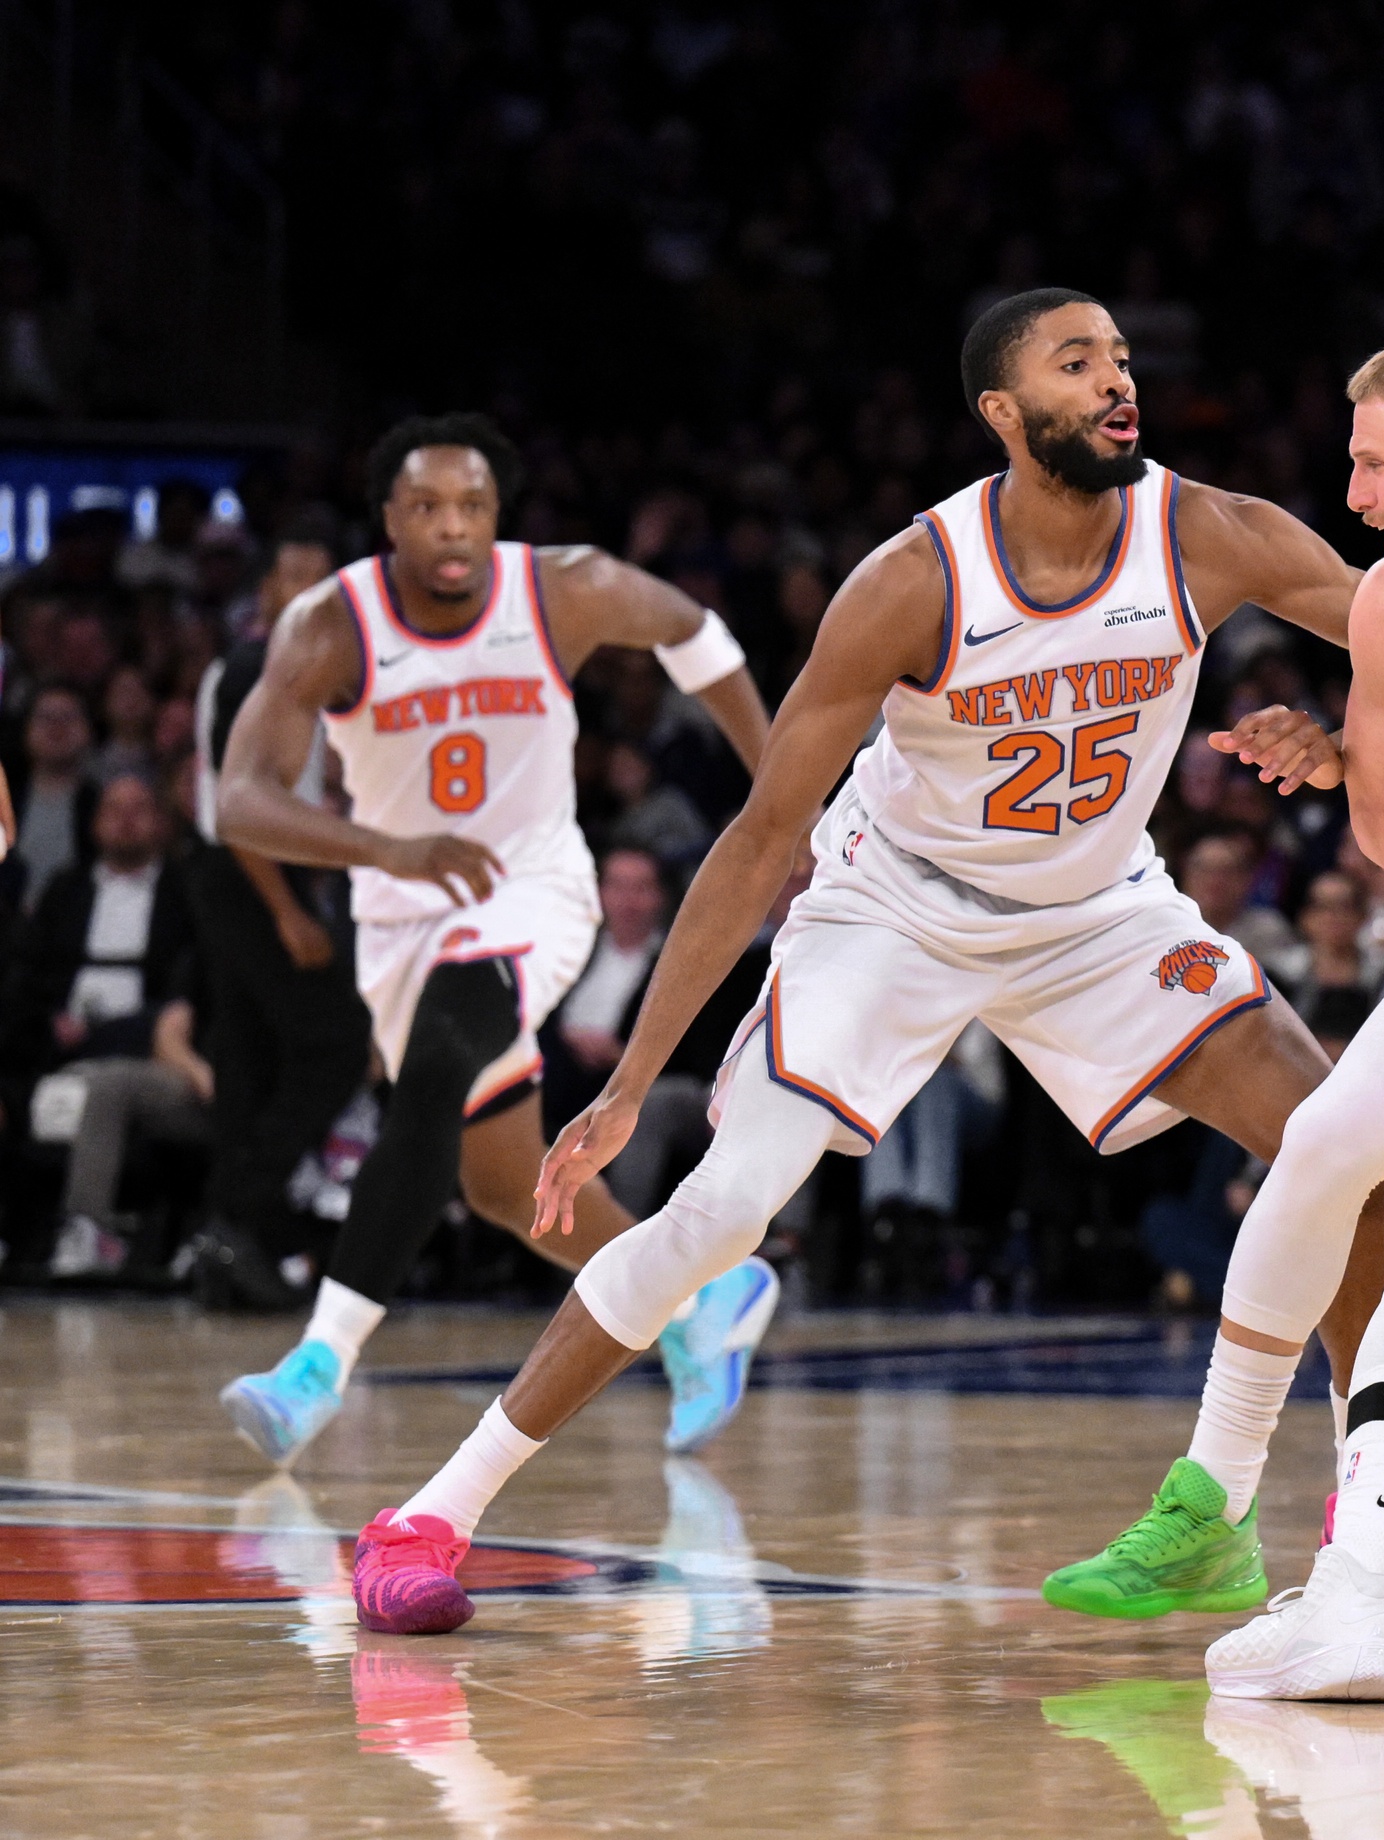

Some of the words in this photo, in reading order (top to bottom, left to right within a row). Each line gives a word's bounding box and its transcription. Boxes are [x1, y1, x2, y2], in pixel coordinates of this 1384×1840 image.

[1104, 605, 1136, 616] experience
[1104, 615, 1128, 628] abu
[1130, 605, 1166, 623] dhabi
[372, 686, 453, 735] NEW
[453, 675, 547, 719] YORK
[947, 667, 1058, 727] NEW
[1062, 652, 1185, 713] YORK
[429, 730, 488, 817] 8
[982, 709, 1141, 836] 25
[1159, 940, 1230, 991] KNICKS
